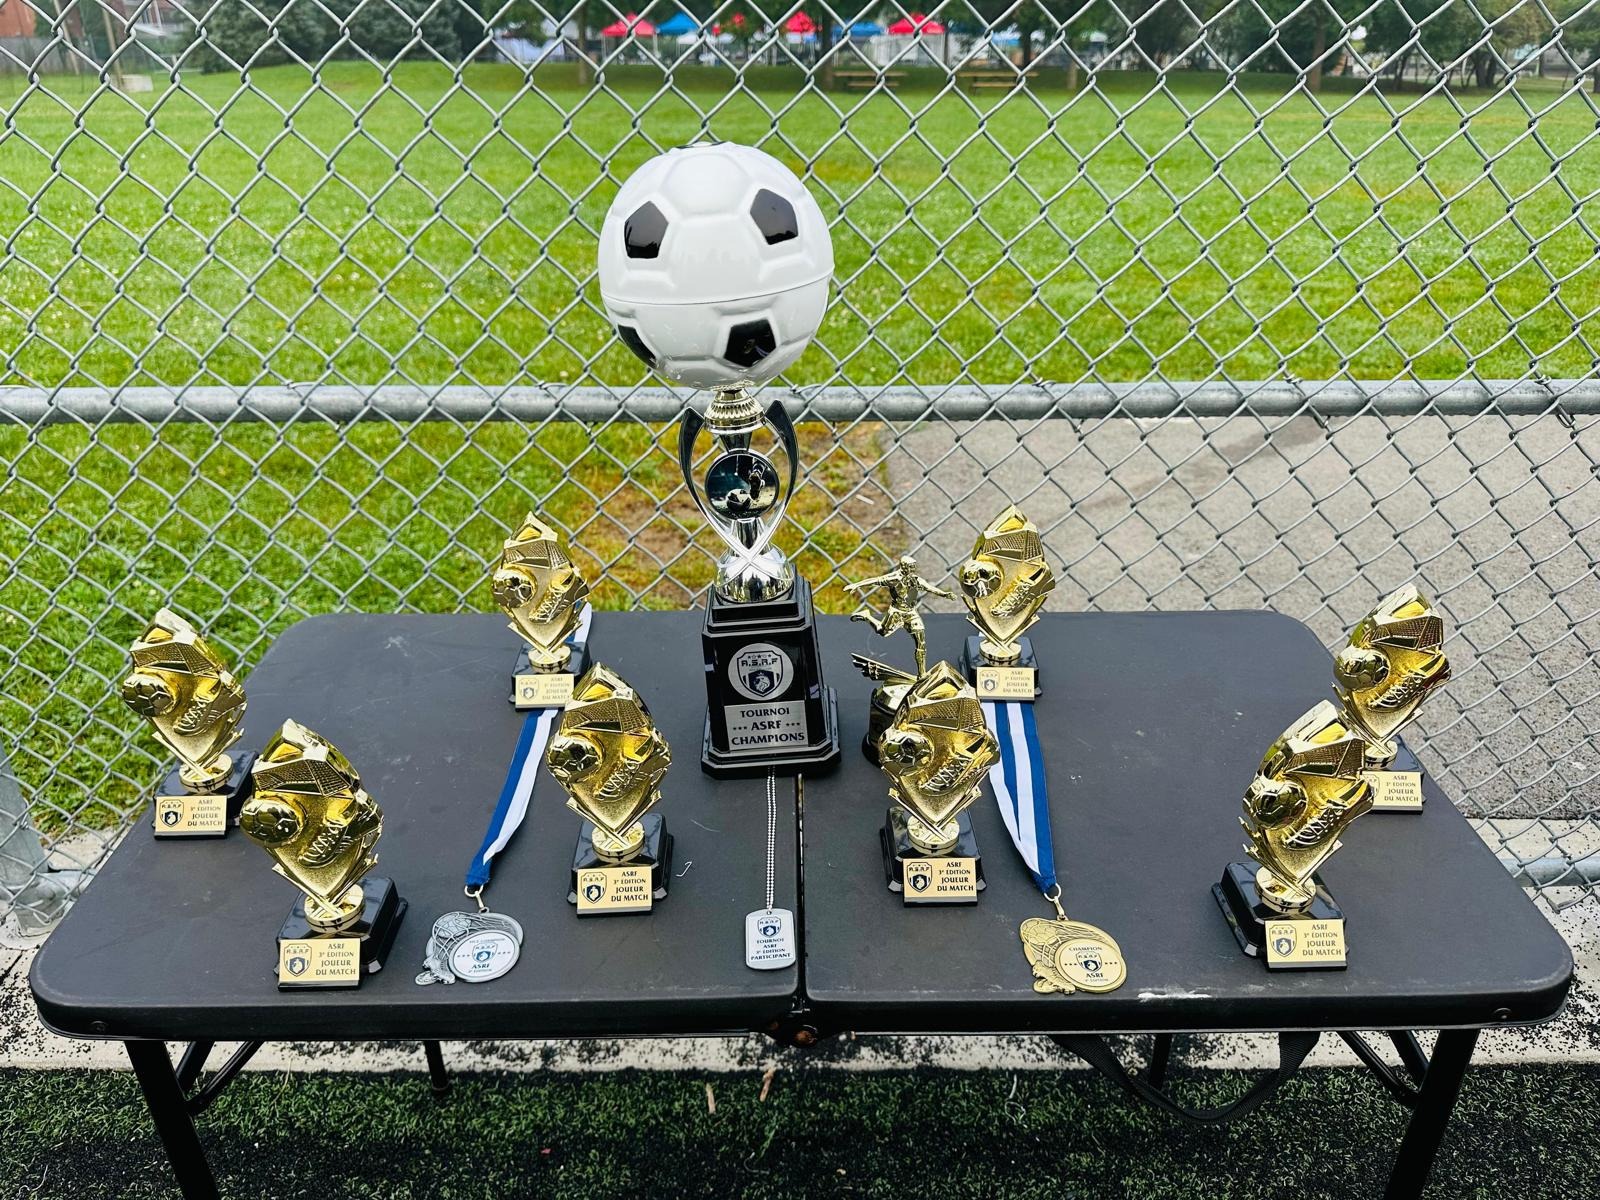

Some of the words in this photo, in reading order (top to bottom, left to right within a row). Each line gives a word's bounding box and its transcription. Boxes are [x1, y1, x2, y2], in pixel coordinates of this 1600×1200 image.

[740, 707, 790, 718] TOURNOI
[751, 720, 782, 731] ASRF
[731, 732, 805, 745] CHAMPIONS
